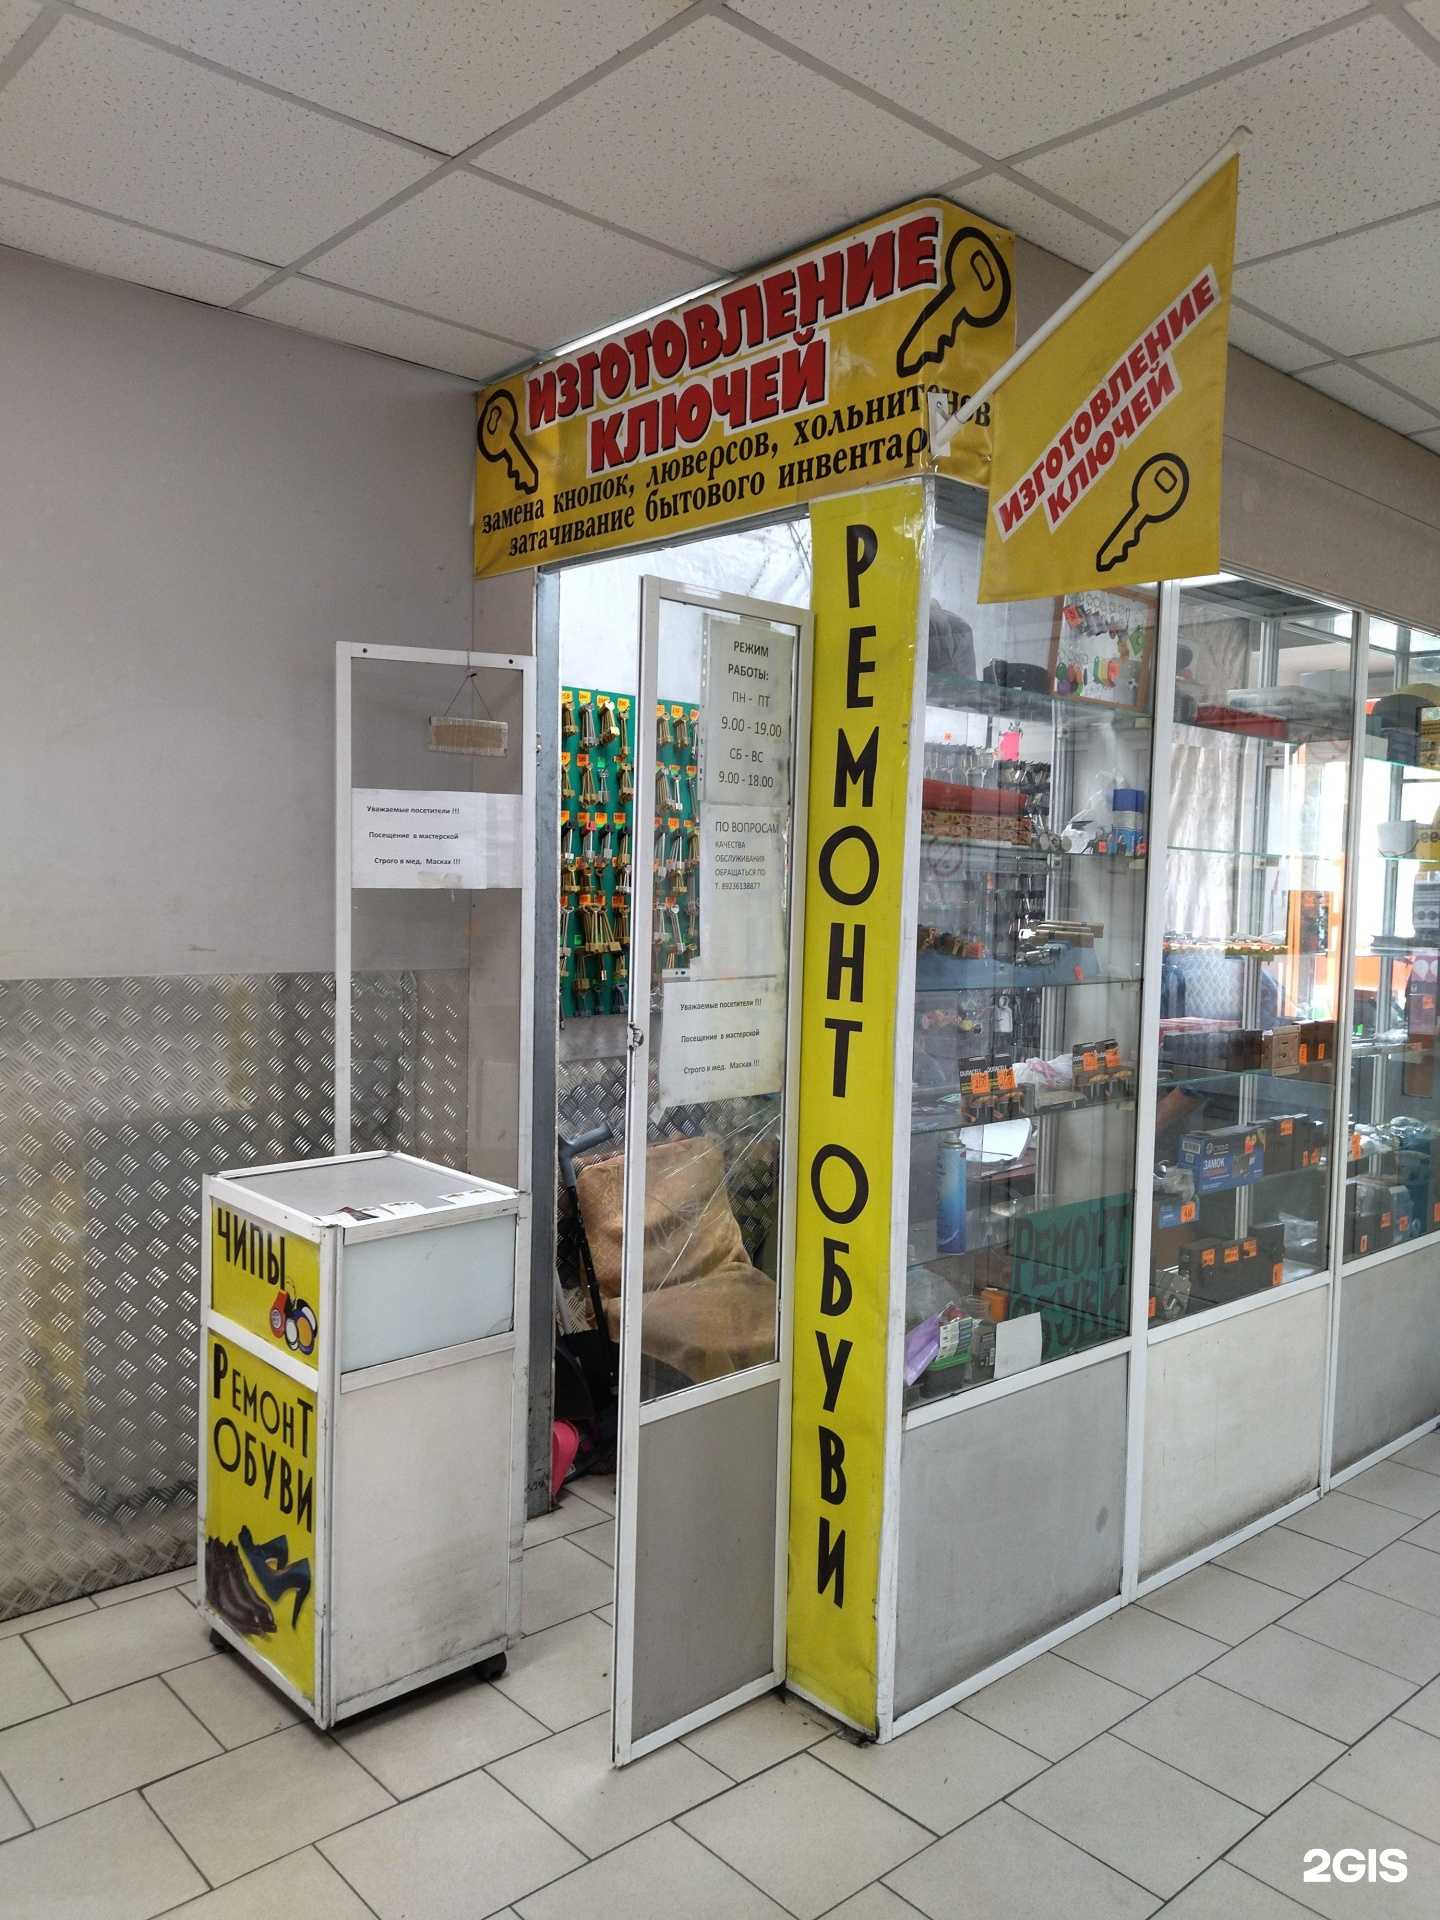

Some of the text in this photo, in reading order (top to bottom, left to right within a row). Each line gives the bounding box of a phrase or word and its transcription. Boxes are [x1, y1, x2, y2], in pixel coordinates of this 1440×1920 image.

[526, 216, 939, 430] ИЗГОТОВЛЕНИЕ
[590, 328, 827, 472] КЛЮЧЕЙ
[998, 273, 1216, 534] ИЗГОТОВЛЕНИЕ
[1046, 361, 1176, 526] КЛЮЧЕЙ
[481, 498, 544, 534] замена
[553, 473, 635, 515] кнопок,
[646, 431, 778, 488] люверсов,
[508, 427, 932, 556] затачивание бытового инвентар
[733, 641, 769, 657] РЕЖИМ
[728, 663, 769, 681] РАБОТЫ:
[732, 691, 746, 704] ПН
[757, 694, 771, 708] ПТ
[721, 716, 745, 732] 9.00
[754, 721, 782, 738] 19.00
[729, 748, 743, 761] СБ
[751, 750, 764, 763] ВС
[718, 771, 740, 785] 9.00
[747, 774, 774, 788] 18.00
[366, 805, 410, 813] Уважаемые
[368, 831, 410, 840] Посещение
[418, 833, 459, 841] мастерской
[715, 821, 779, 834] ПО ВОПРОСАМ
[714, 840, 746, 849] КАЧЕСТВА
[374, 857, 399, 866] Строго
[714, 854, 765, 863] ОБСЛУЖИВАНИЯ
[714, 868, 756, 877] ОБРАЩАТЬСЯ
[680, 1002, 719, 1011] Уважаемые
[719, 1000, 754, 1009] посетители
[681, 1034, 718, 1043] Посещение
[725, 1029, 760, 1039] мастерской
[683, 1065, 706, 1074] Строго
[729, 1061, 752, 1069] Масках
[810, 524, 879, 1609] РЕМОНТ ОБУВИ
[1203, 1158, 1225, 1170] ЗАМОК
[216, 1206, 287, 1291] ЧИПЫ
[212, 1342, 314, 1459] РЕМОНТ
[212, 1416, 314, 1535] ОБУВИ
